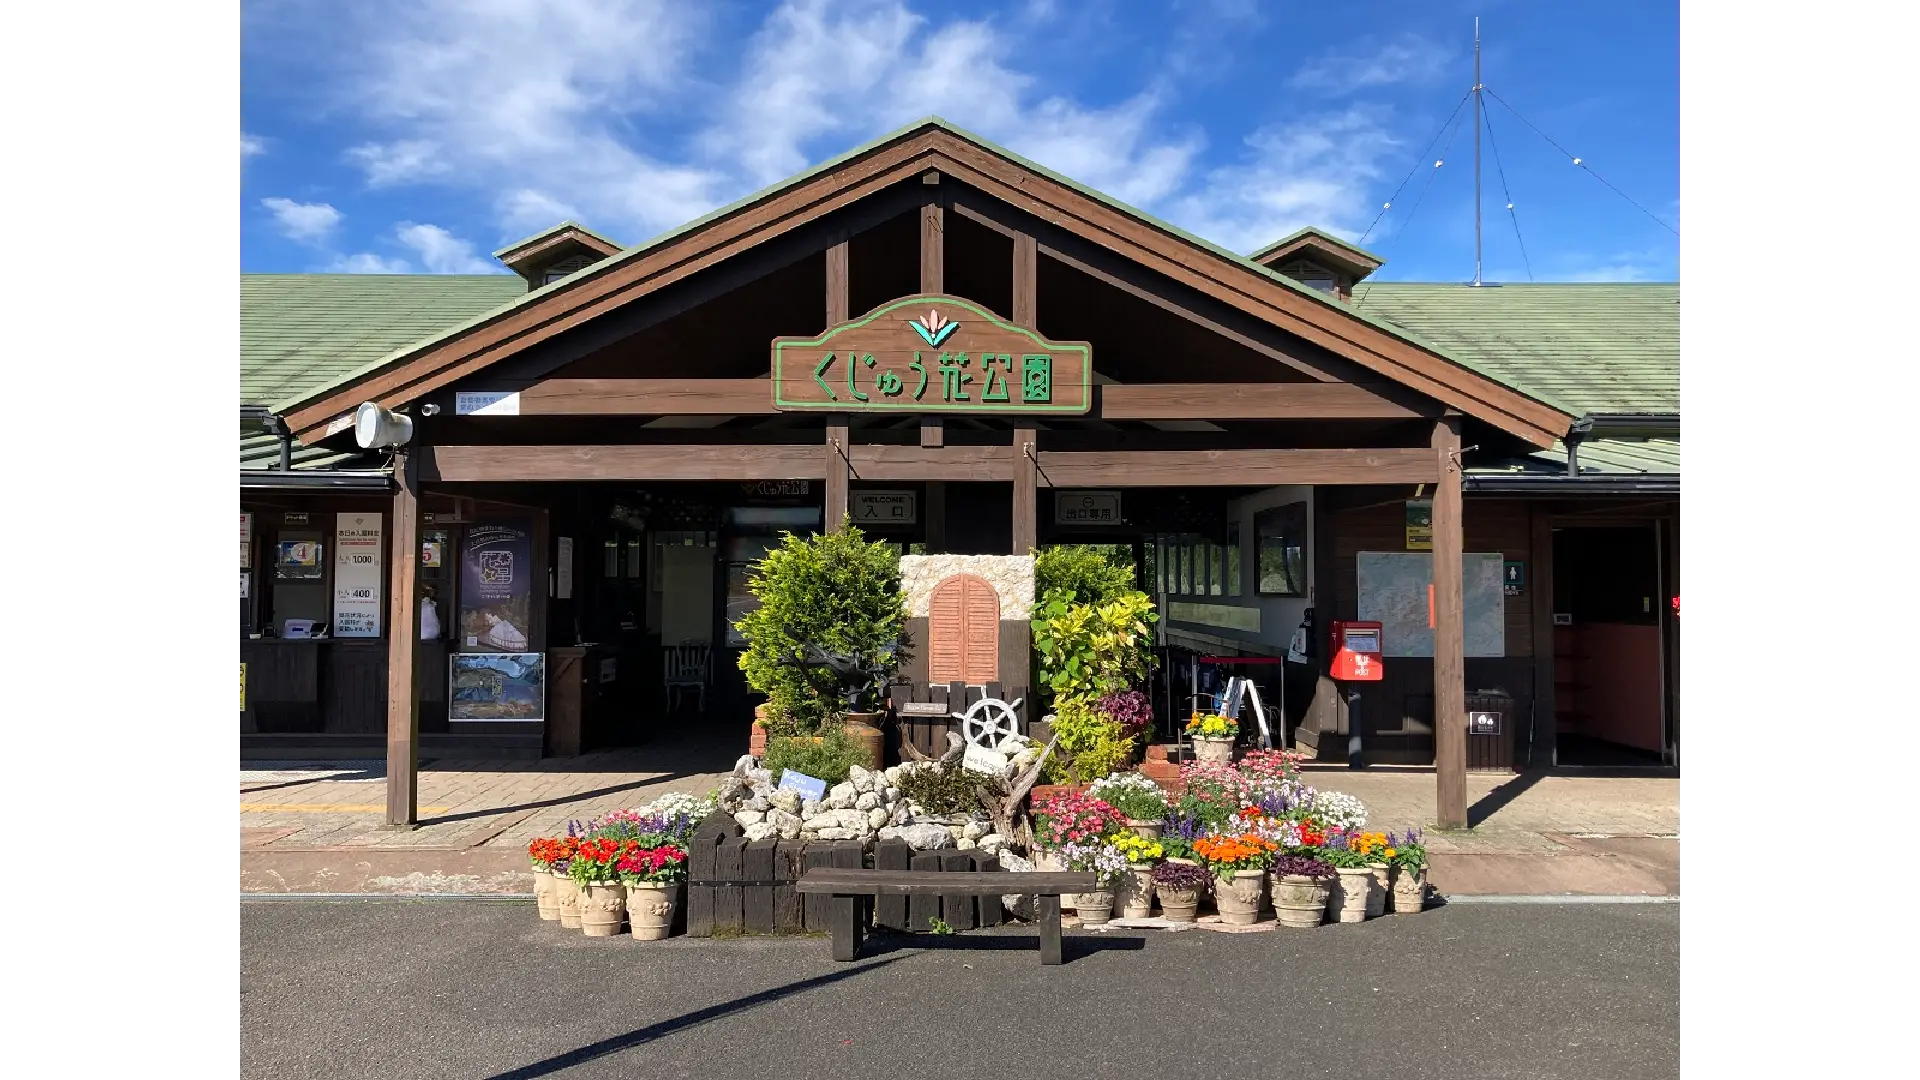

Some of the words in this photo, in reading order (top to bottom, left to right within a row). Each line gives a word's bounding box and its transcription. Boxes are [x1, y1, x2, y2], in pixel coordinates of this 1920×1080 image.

[814, 351, 1052, 402] くじゅう花公園
[757, 480, 809, 495] くじゅう花公園
[865, 506, 904, 518] 入口
